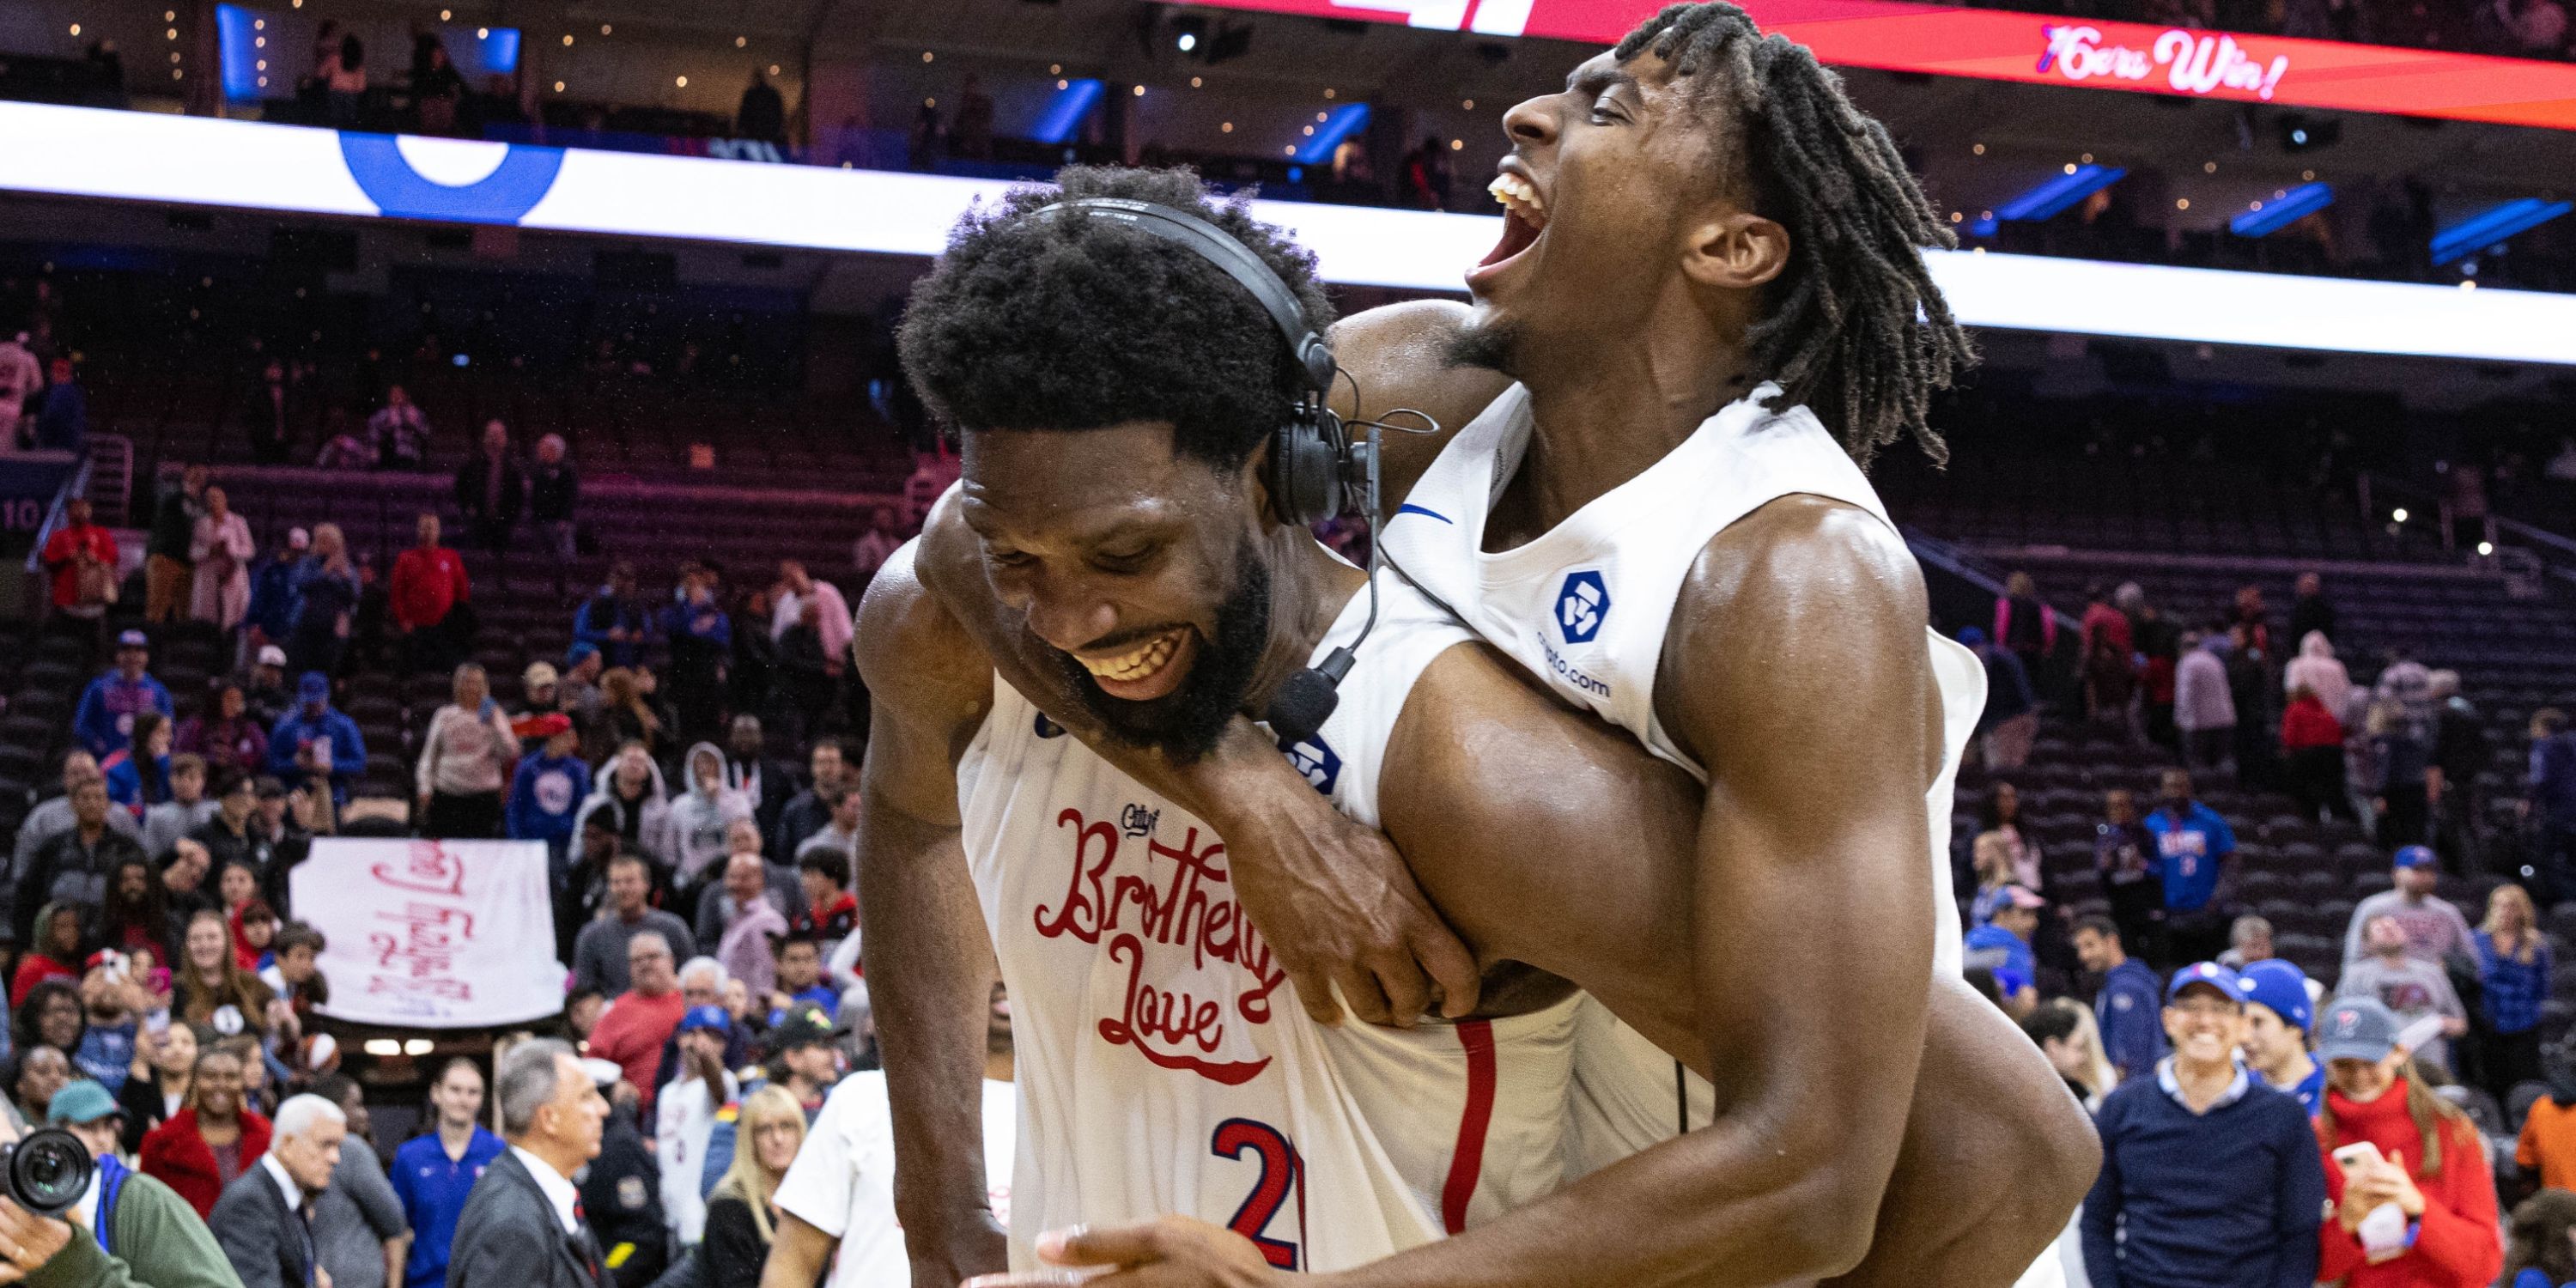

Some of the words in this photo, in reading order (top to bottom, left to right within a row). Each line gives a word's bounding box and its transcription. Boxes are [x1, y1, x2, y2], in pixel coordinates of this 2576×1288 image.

[2038, 25, 2152, 79] 76ers
[2154, 29, 2288, 100] Win!
[1536, 631, 1610, 697] cpto.com
[1034, 808, 1286, 1024] Brotherly
[1098, 933, 1273, 1085] Love
